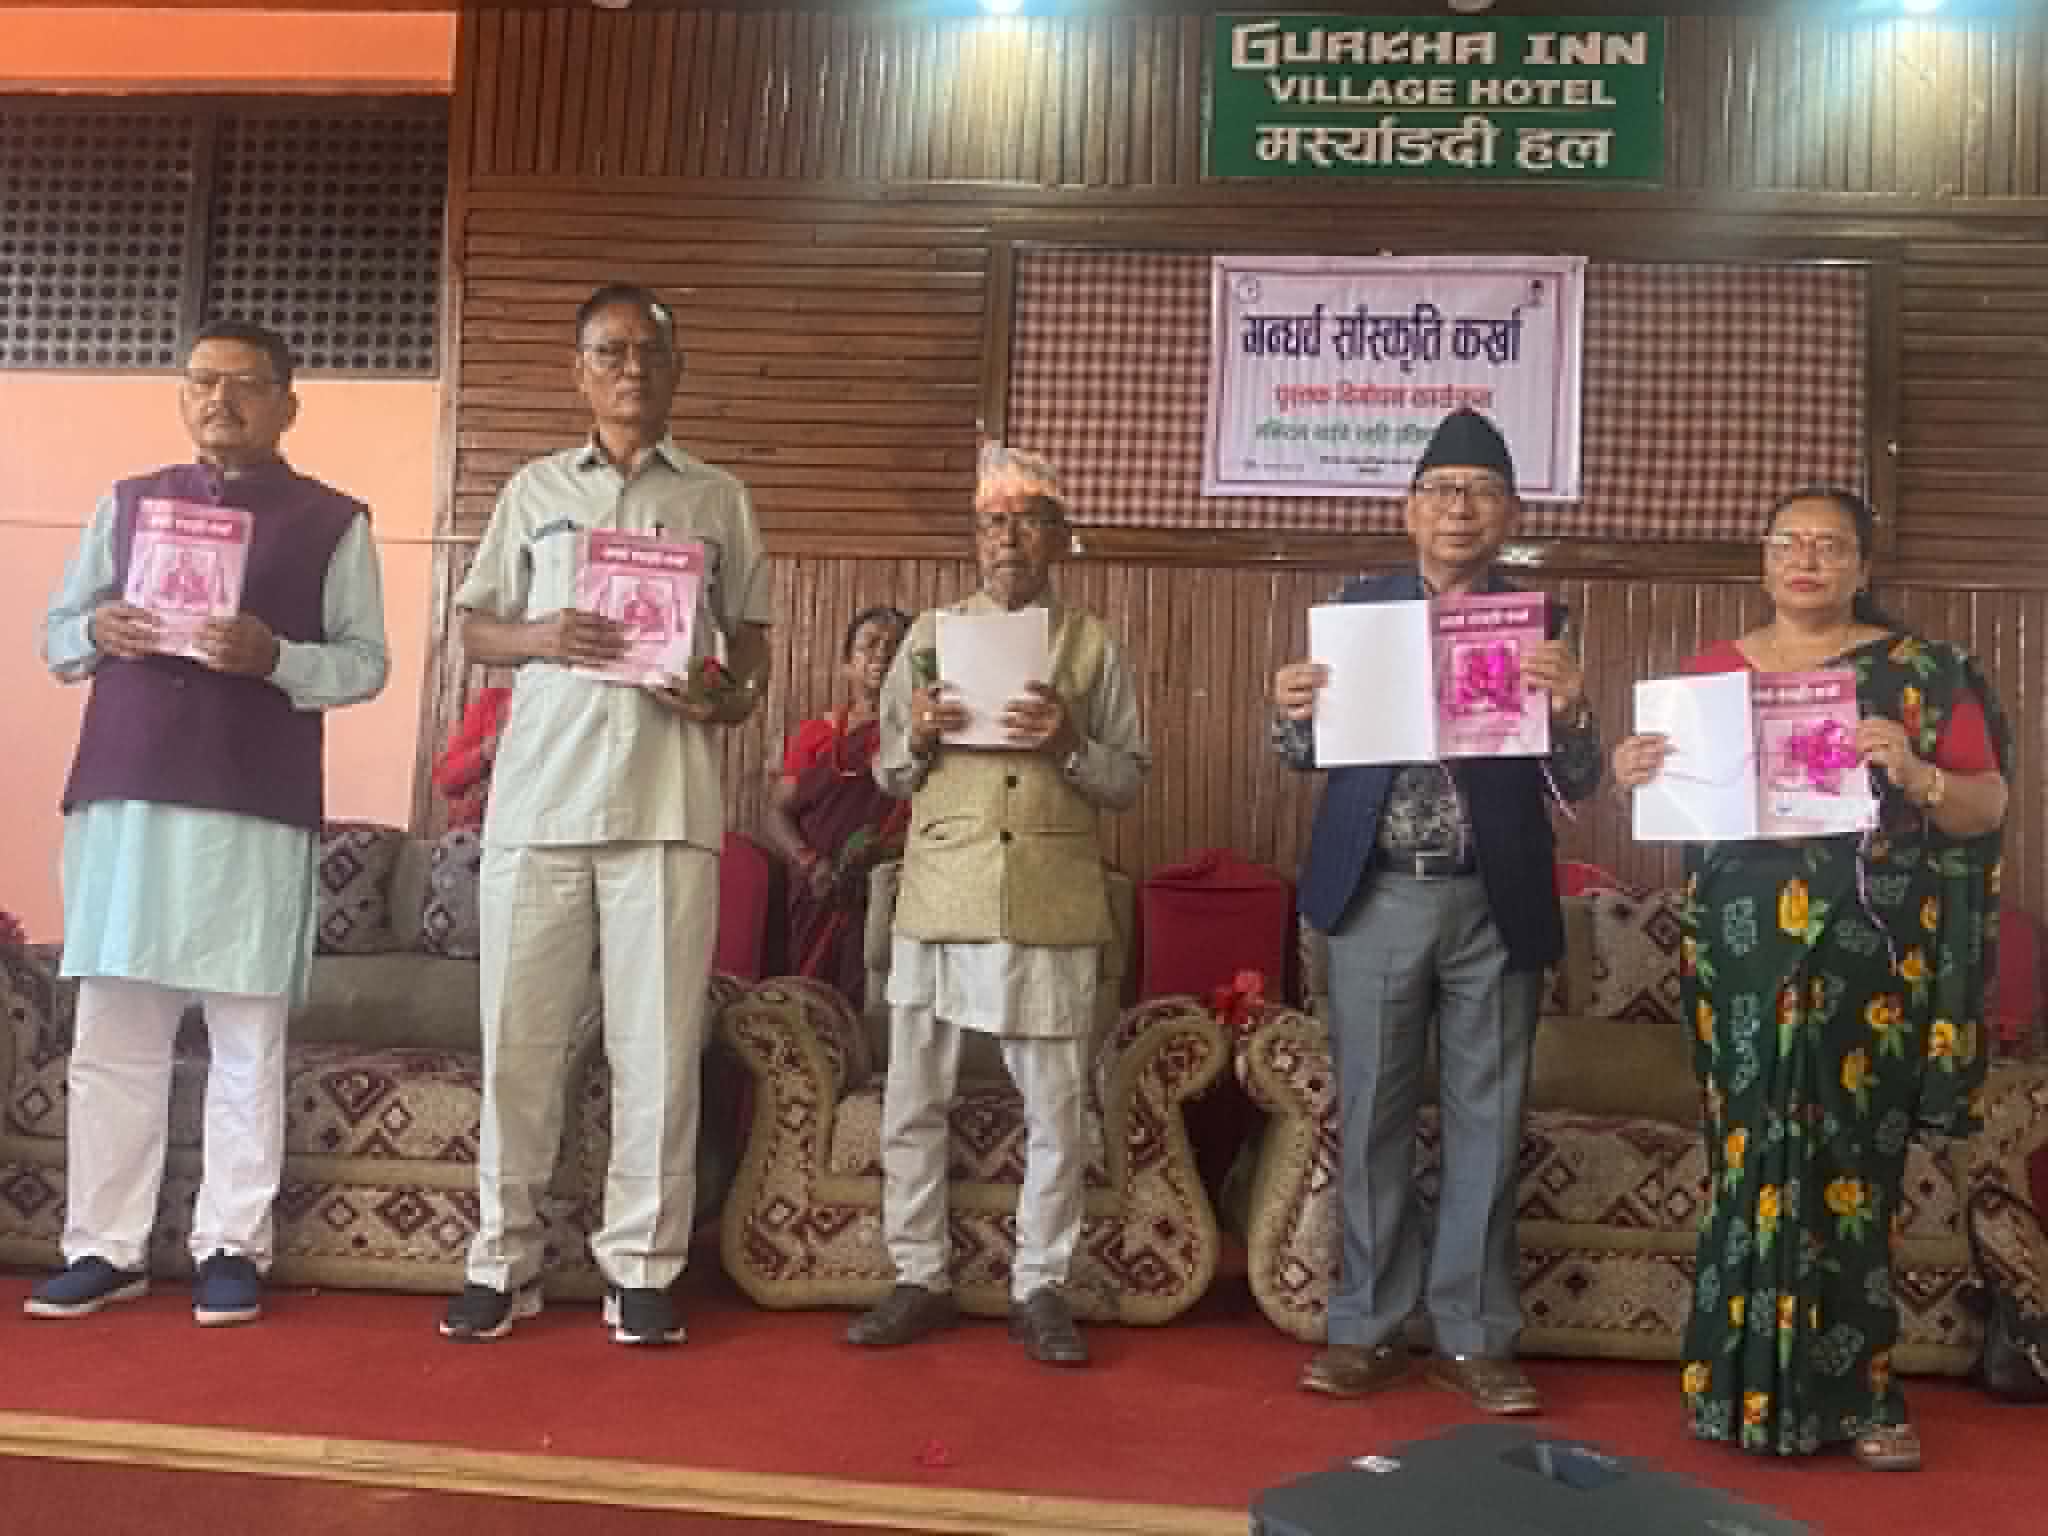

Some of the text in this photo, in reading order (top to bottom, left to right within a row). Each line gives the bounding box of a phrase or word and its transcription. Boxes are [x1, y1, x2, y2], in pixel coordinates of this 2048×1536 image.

[1232, 23, 1648, 70] GURKHA INN
[1265, 76, 1616, 105] VILLAGE HOTEL
[1515, 127, 1615, 169] हल
